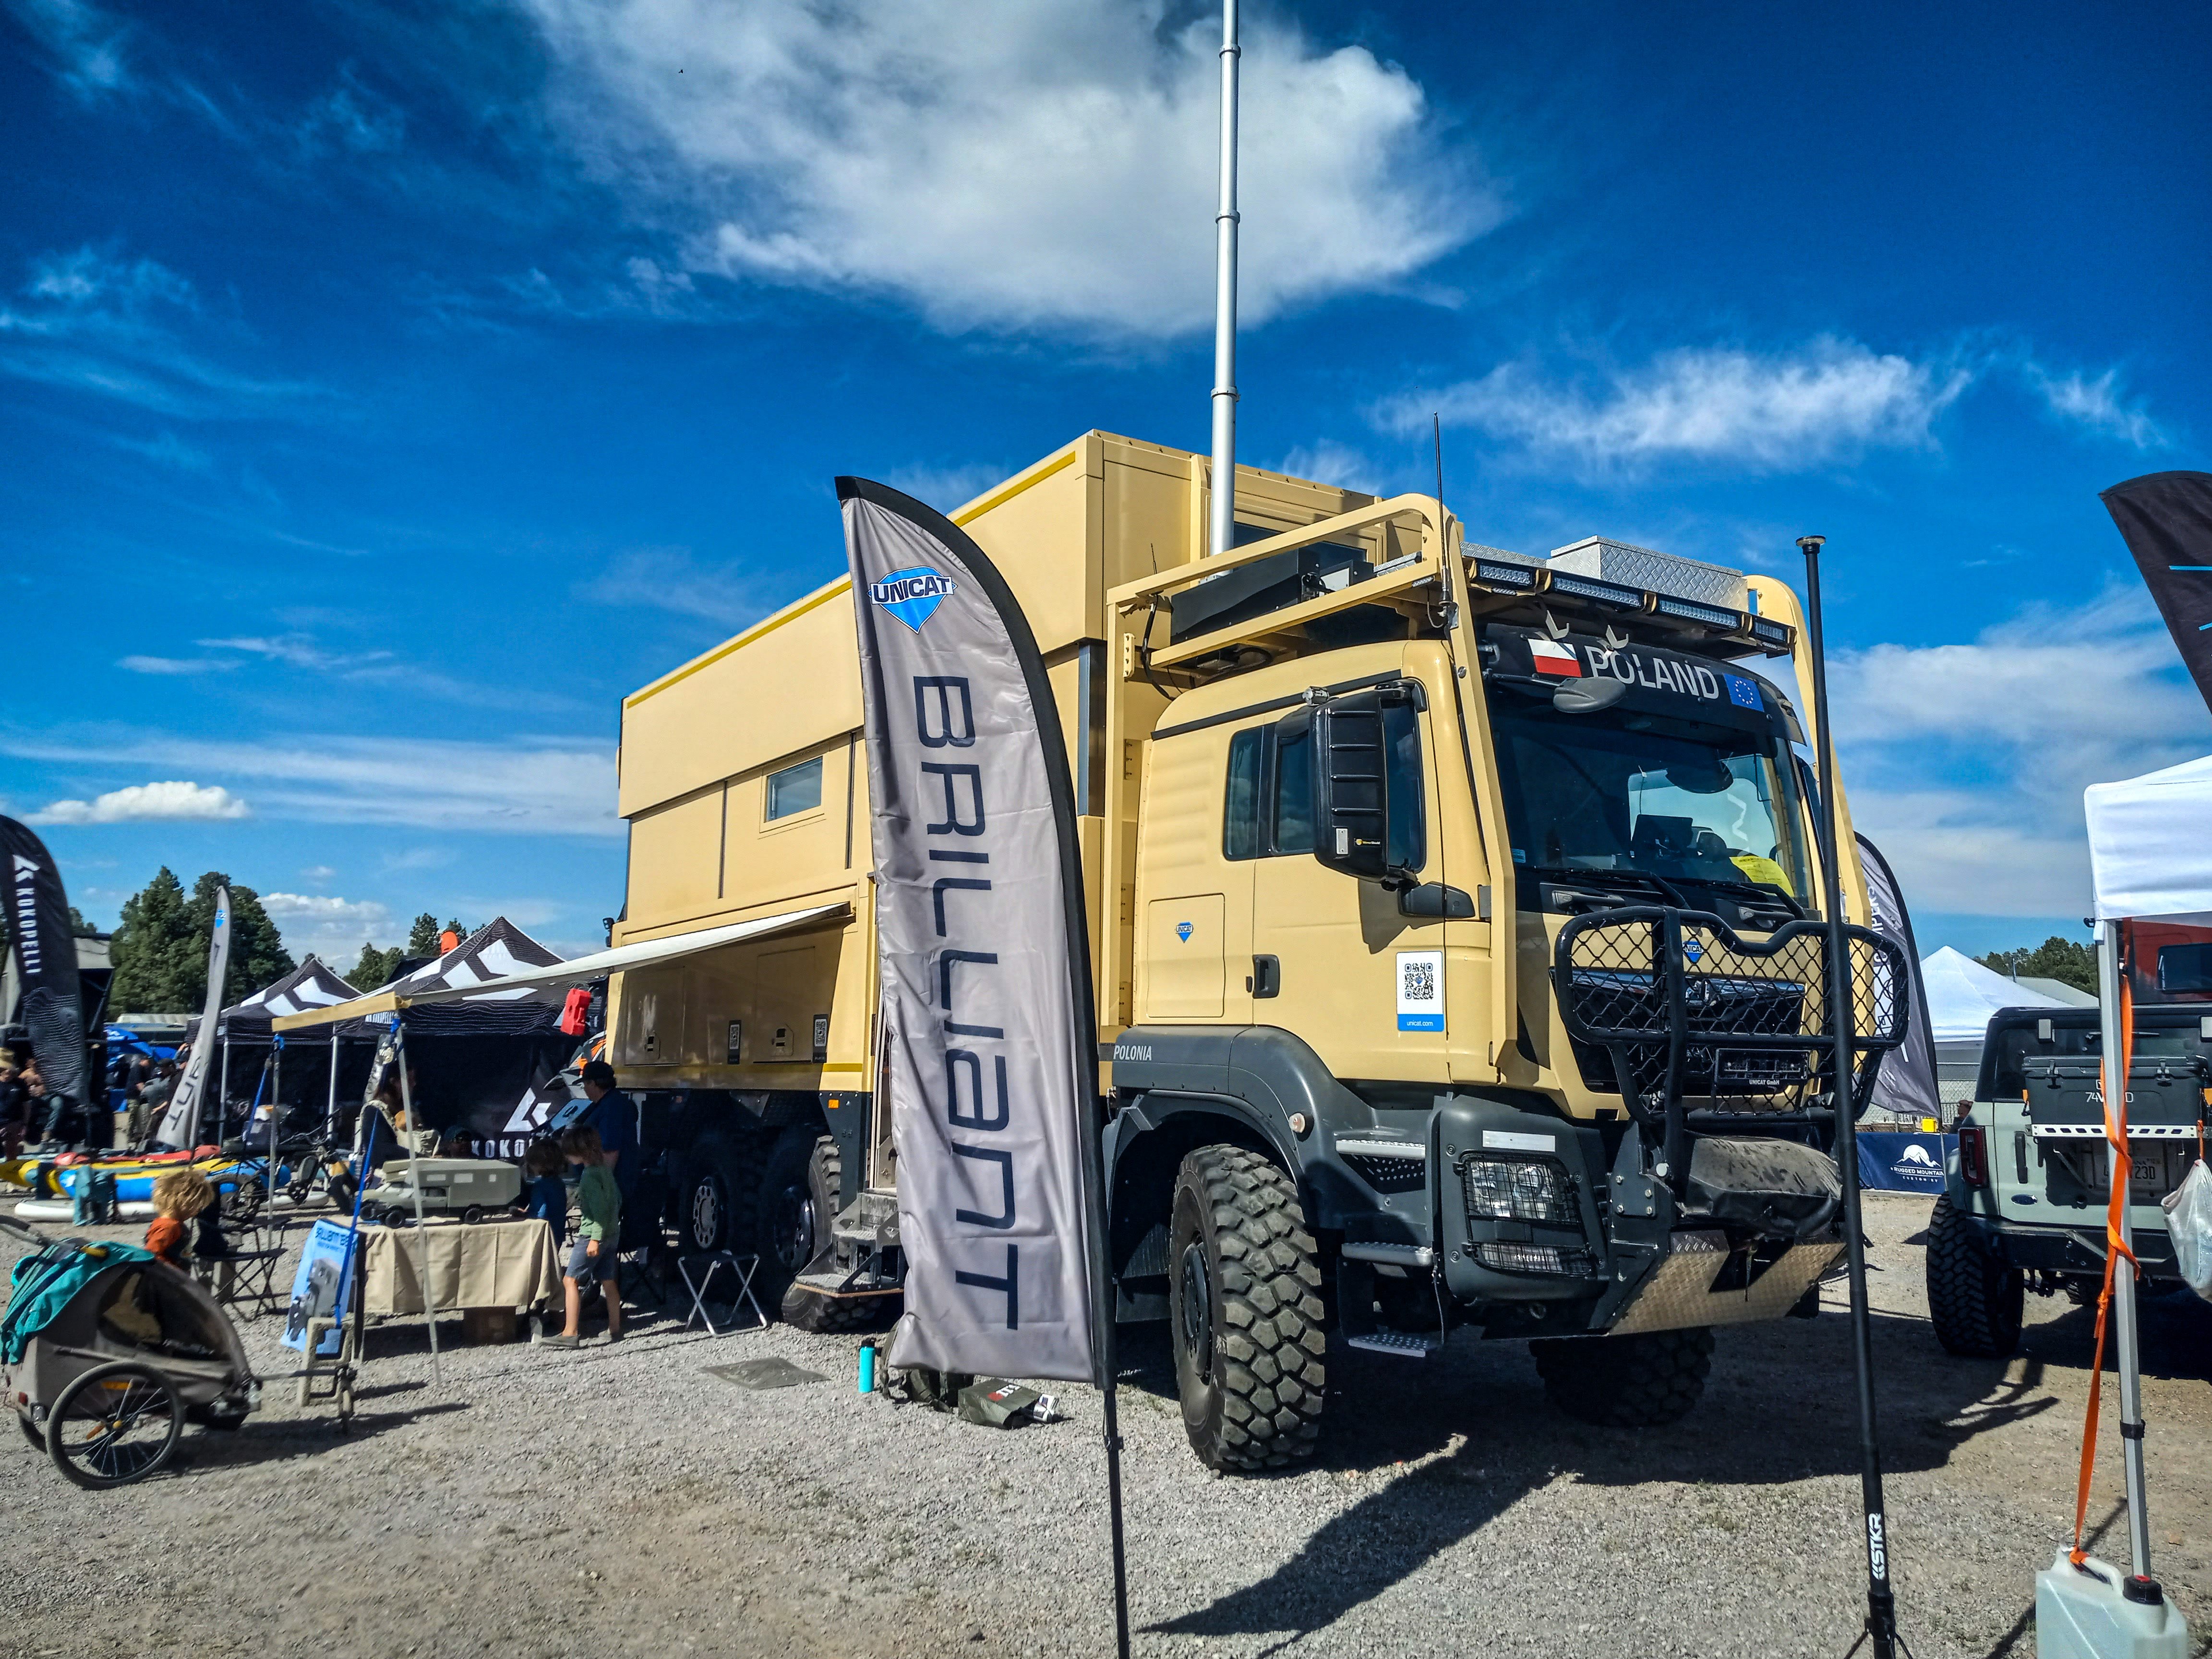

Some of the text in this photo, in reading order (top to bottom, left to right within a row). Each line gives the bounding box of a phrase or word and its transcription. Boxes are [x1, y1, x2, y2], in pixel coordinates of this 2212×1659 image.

[873, 576, 951, 603] UNICAT
[1585, 645, 1719, 699] POLAND
[16, 888, 42, 974] KOKOPELLI
[1113, 1045, 1152, 1061] POLONIA
